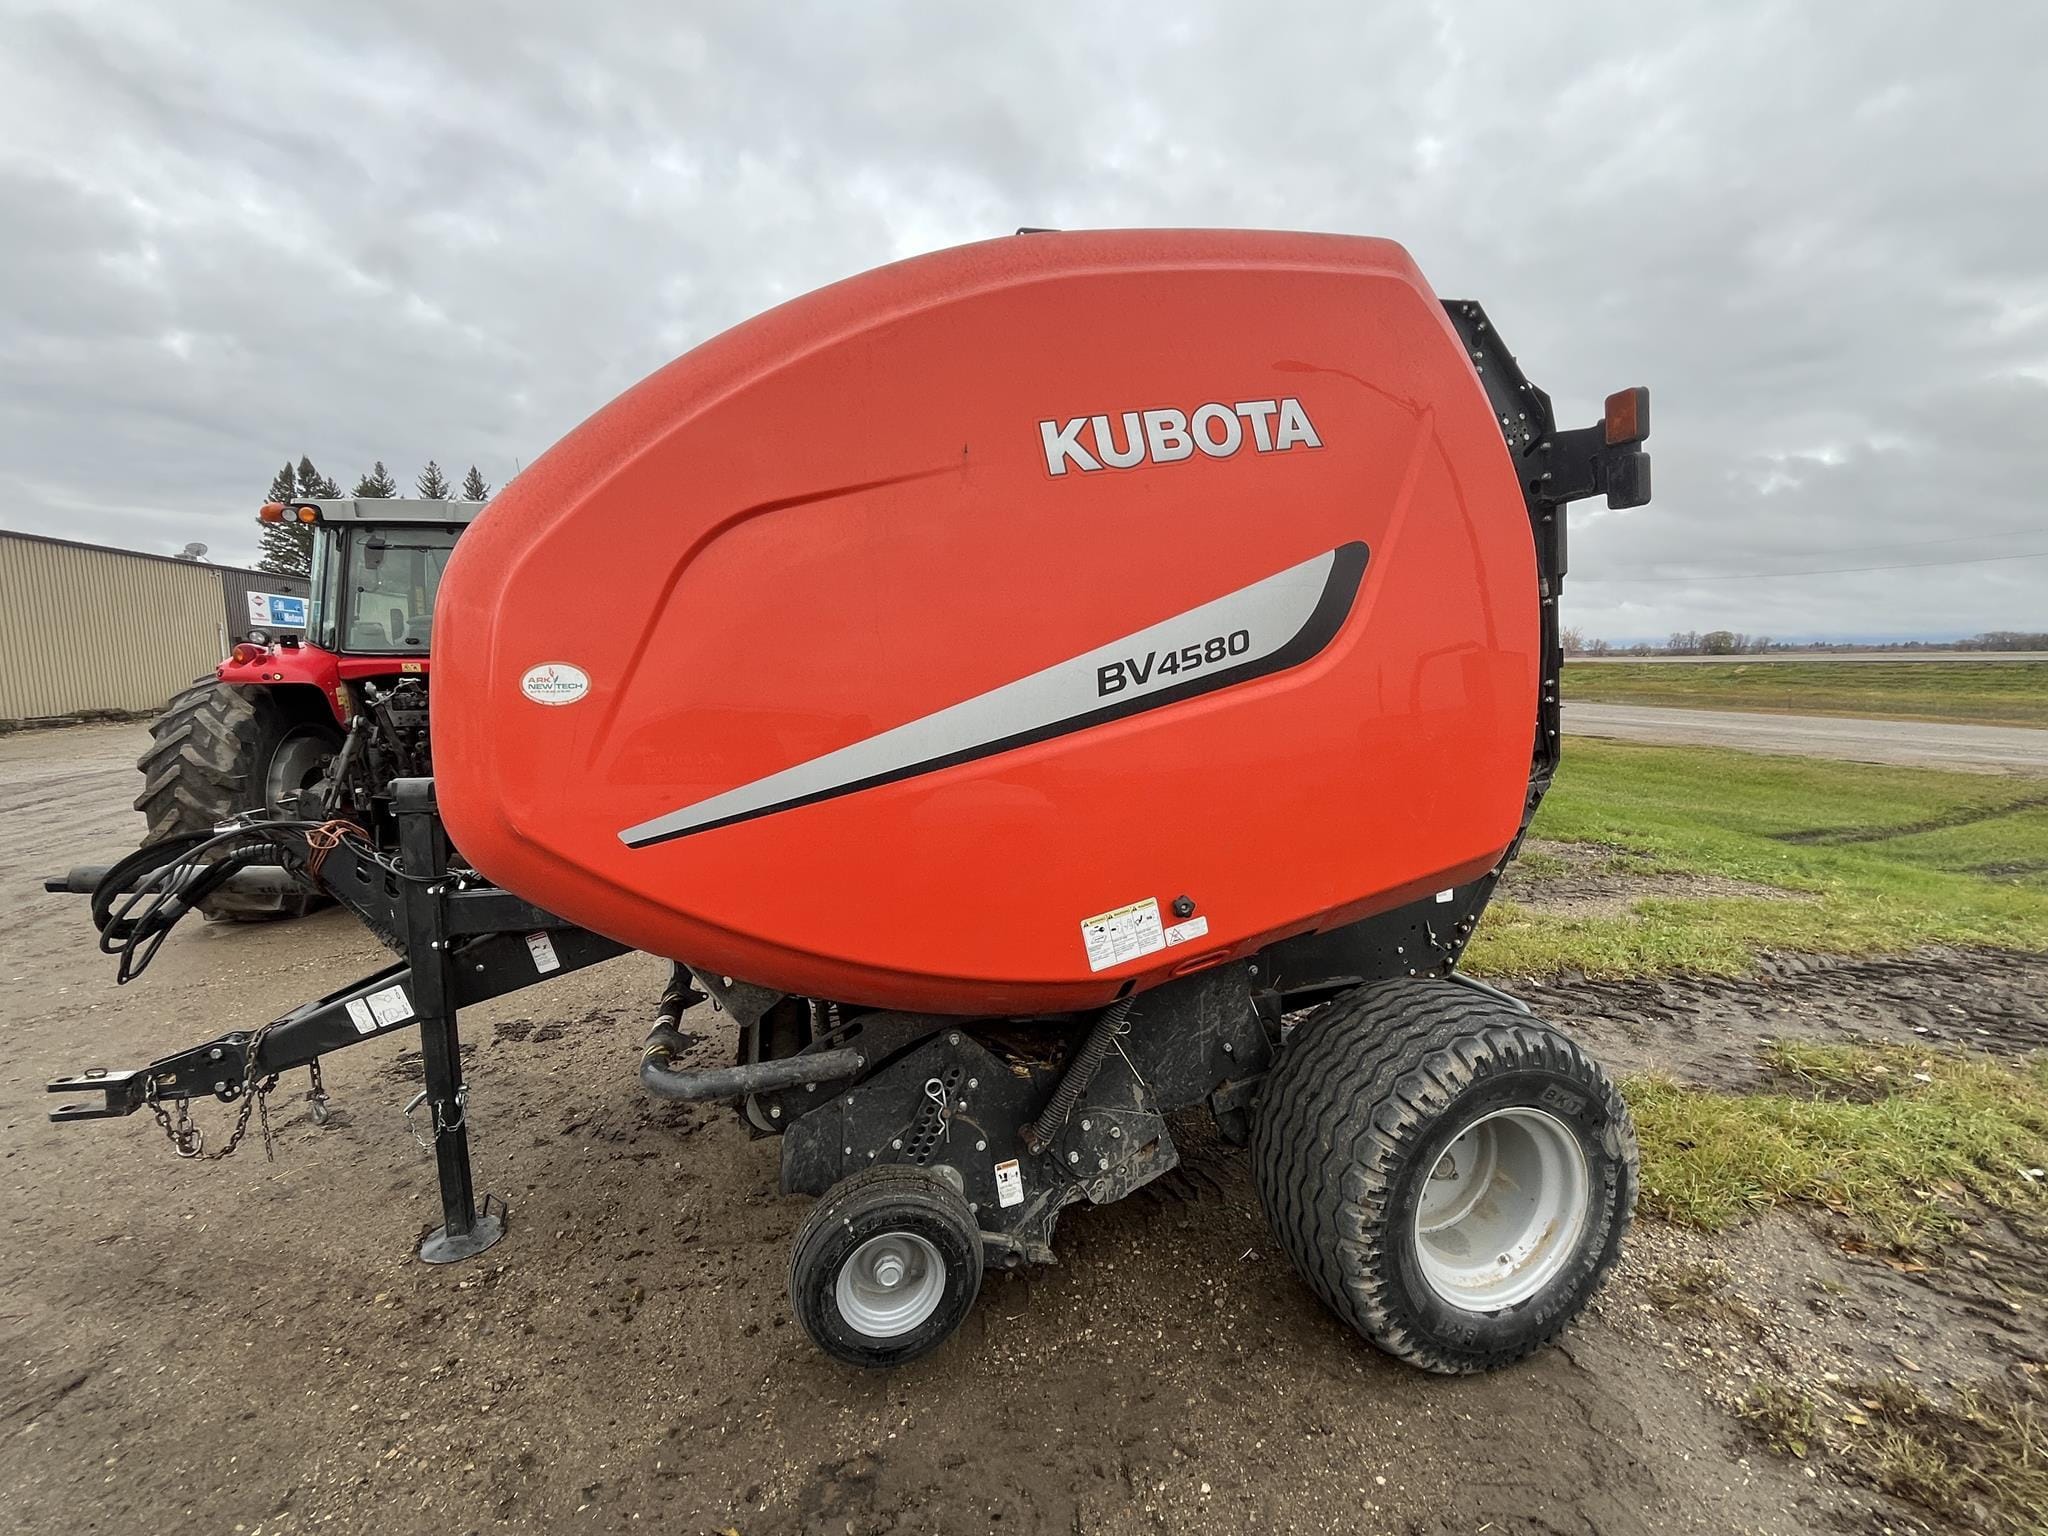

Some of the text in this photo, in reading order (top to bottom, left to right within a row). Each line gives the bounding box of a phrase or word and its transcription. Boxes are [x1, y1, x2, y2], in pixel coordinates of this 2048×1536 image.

[1040, 398, 1323, 475] KUBOTA
[1097, 629, 1250, 697] BV4580
[1543, 1089, 1581, 1113] BKT
